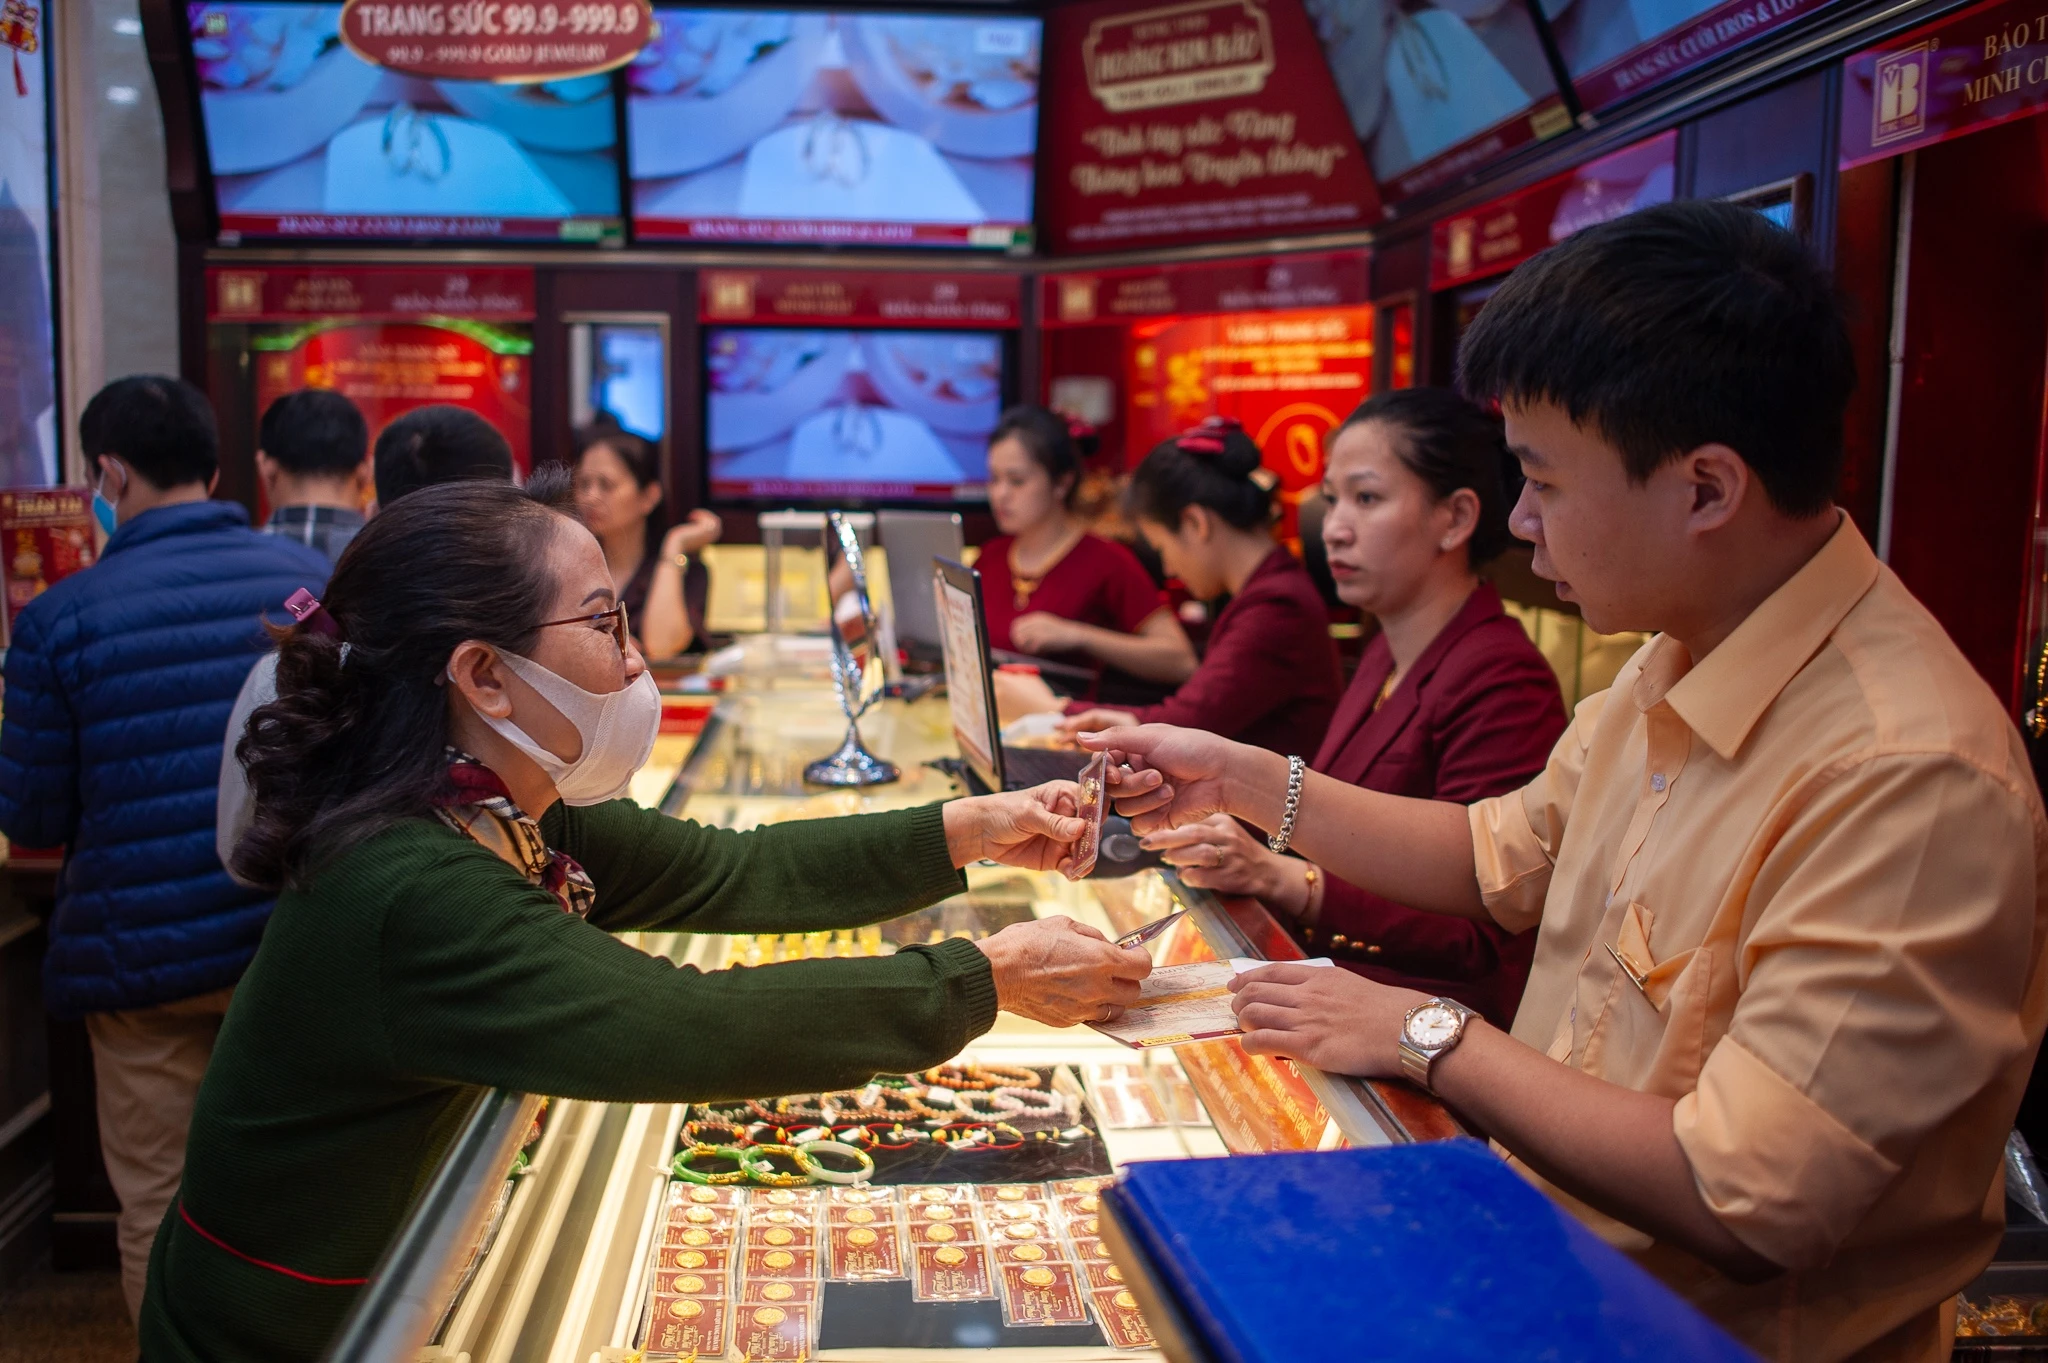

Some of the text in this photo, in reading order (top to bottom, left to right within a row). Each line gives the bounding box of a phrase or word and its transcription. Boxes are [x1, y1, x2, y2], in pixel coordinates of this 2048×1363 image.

[356, 4, 445, 36] TRANG
[449, 0, 500, 36] SỨC
[483, 43, 532, 64] GOLD
[1984, 22, 2030, 60] BẢO
[1963, 65, 2021, 106] MINH
